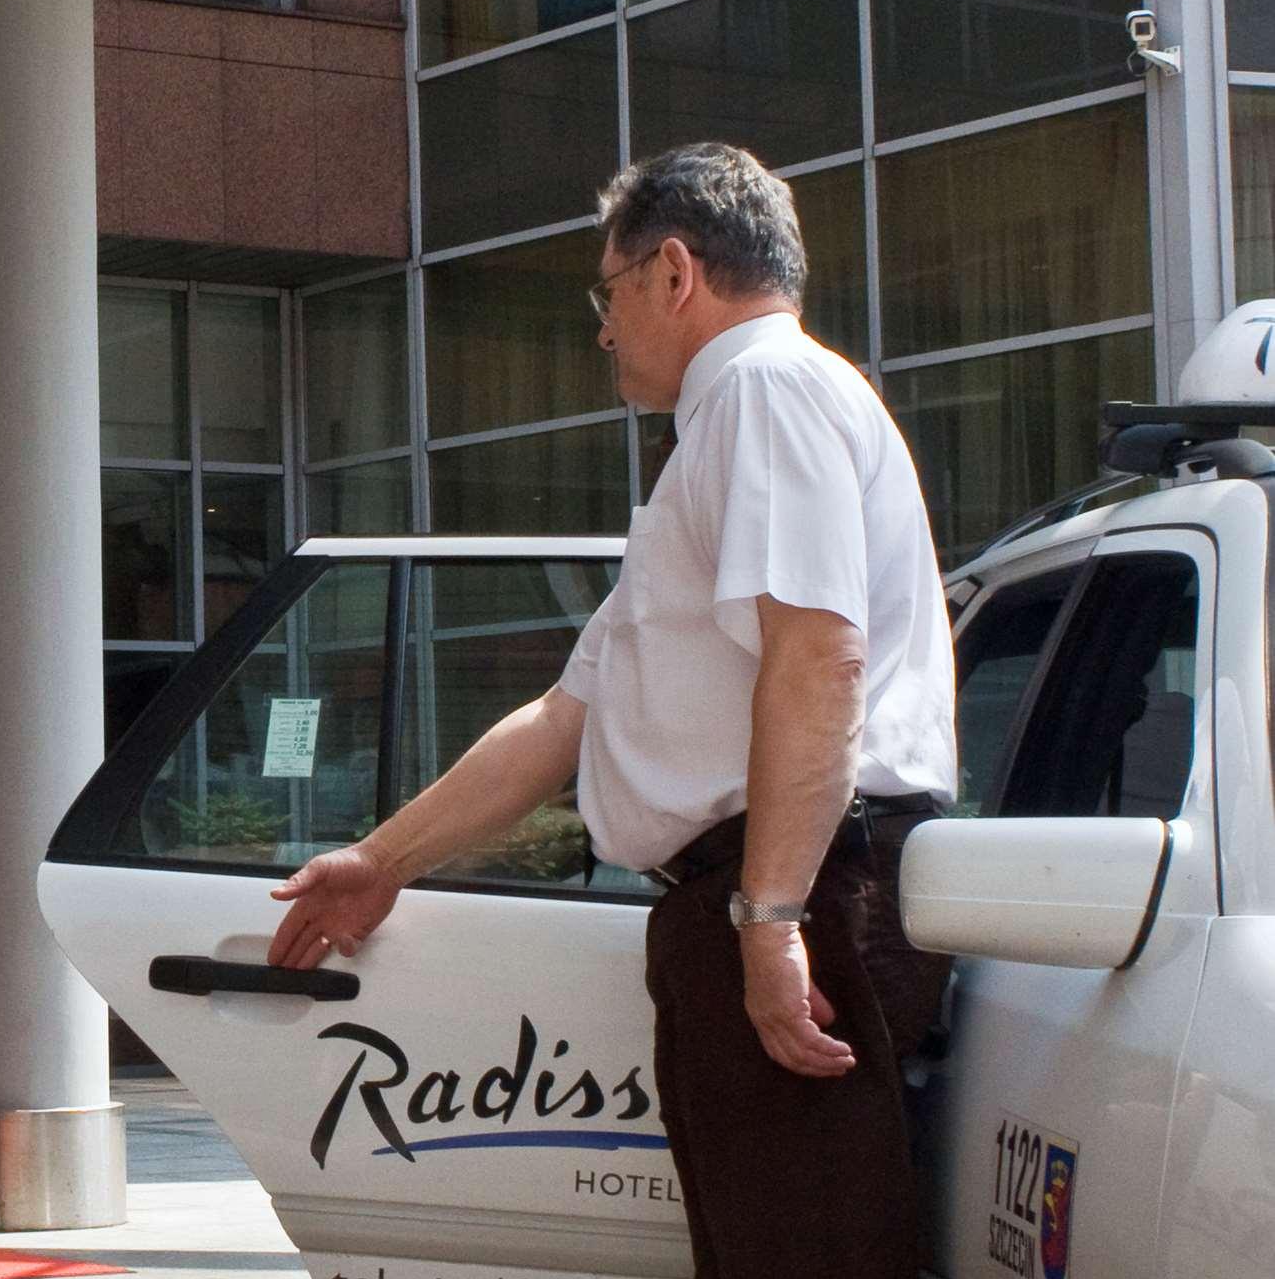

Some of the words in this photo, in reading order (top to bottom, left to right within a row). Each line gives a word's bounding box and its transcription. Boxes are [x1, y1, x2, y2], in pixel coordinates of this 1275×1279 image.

[310, 1014, 651, 1170] Radiss
[574, 1170, 682, 1202] HOTEL
[996, 1119, 1041, 1225] 1122
